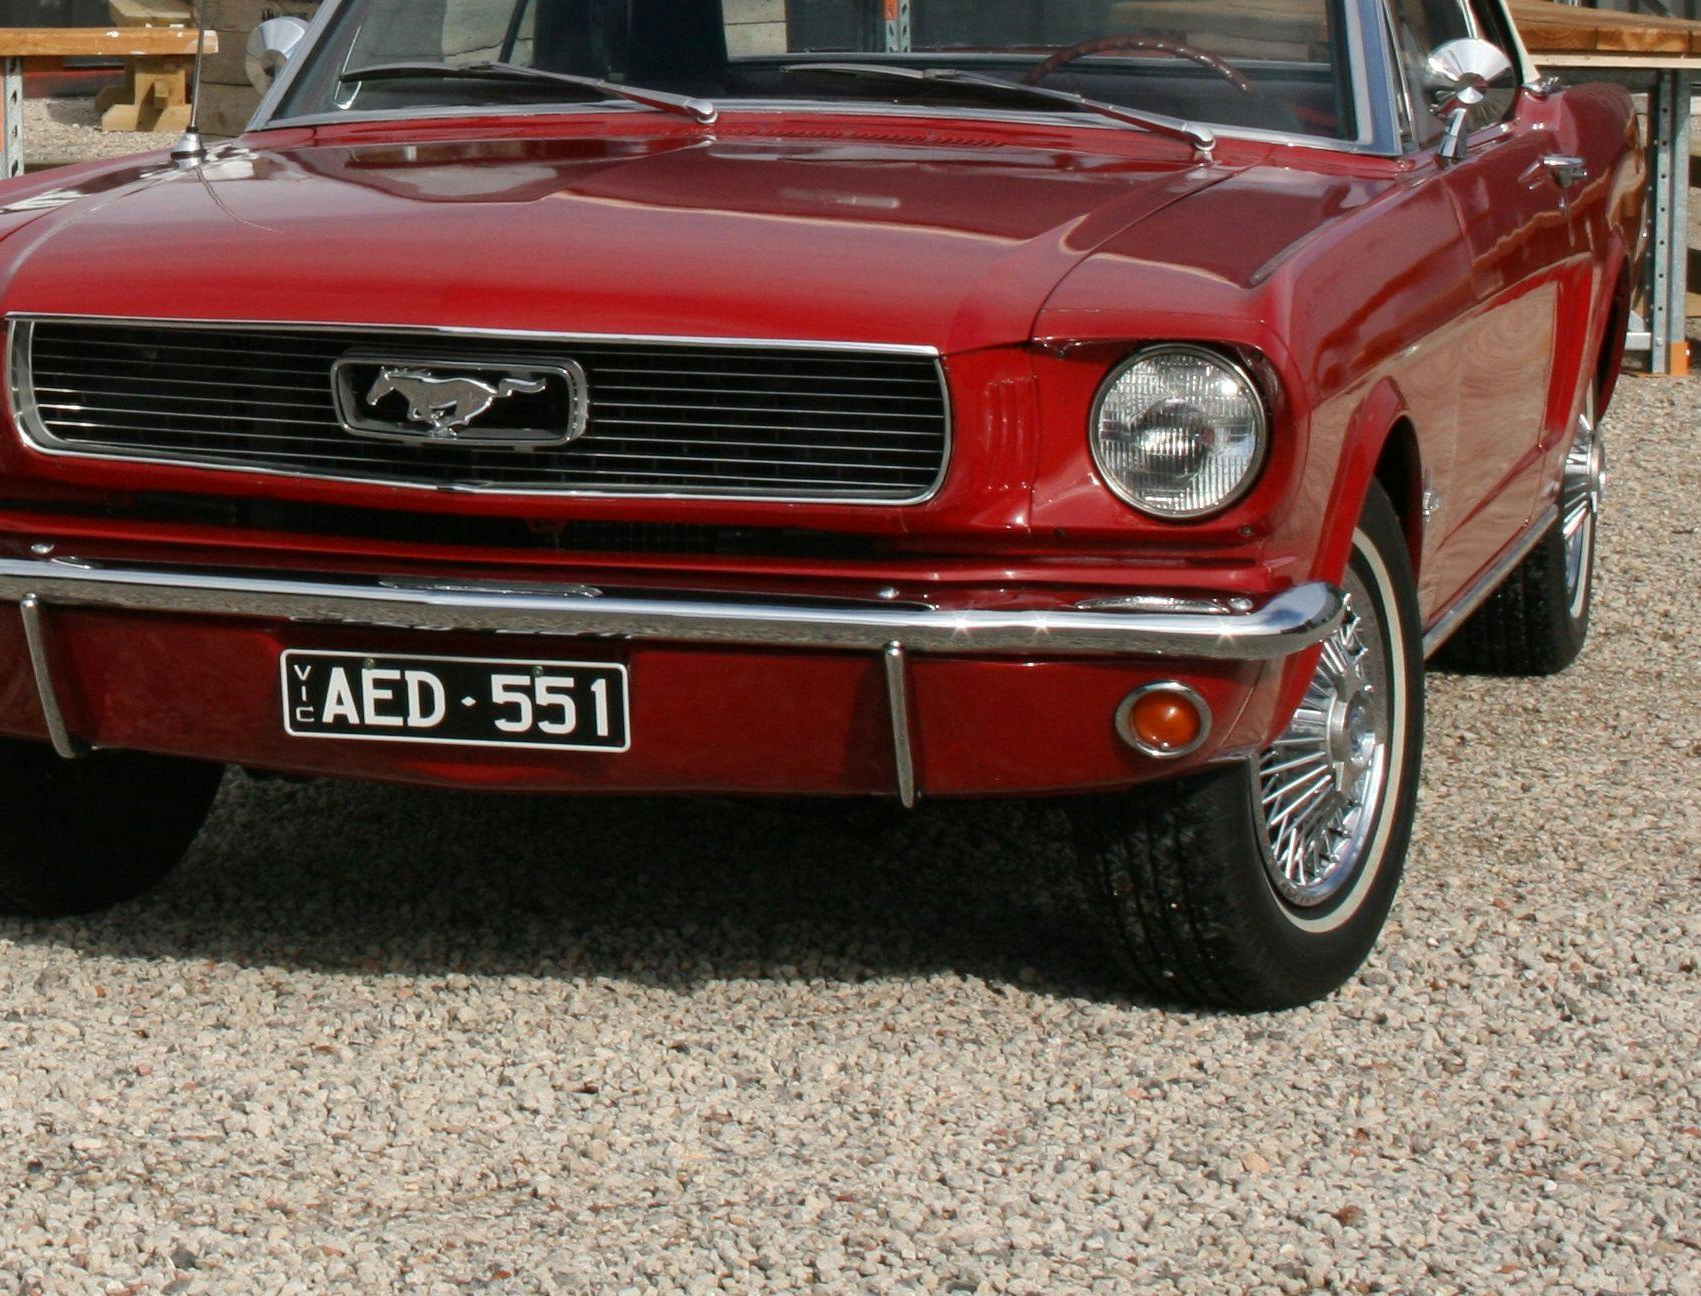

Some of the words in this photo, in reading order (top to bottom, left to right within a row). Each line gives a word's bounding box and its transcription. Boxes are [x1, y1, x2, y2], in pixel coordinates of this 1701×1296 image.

[293, 664, 315, 723] VIC
[321, 666, 446, 728] AED
[490, 673, 610, 738] 551
